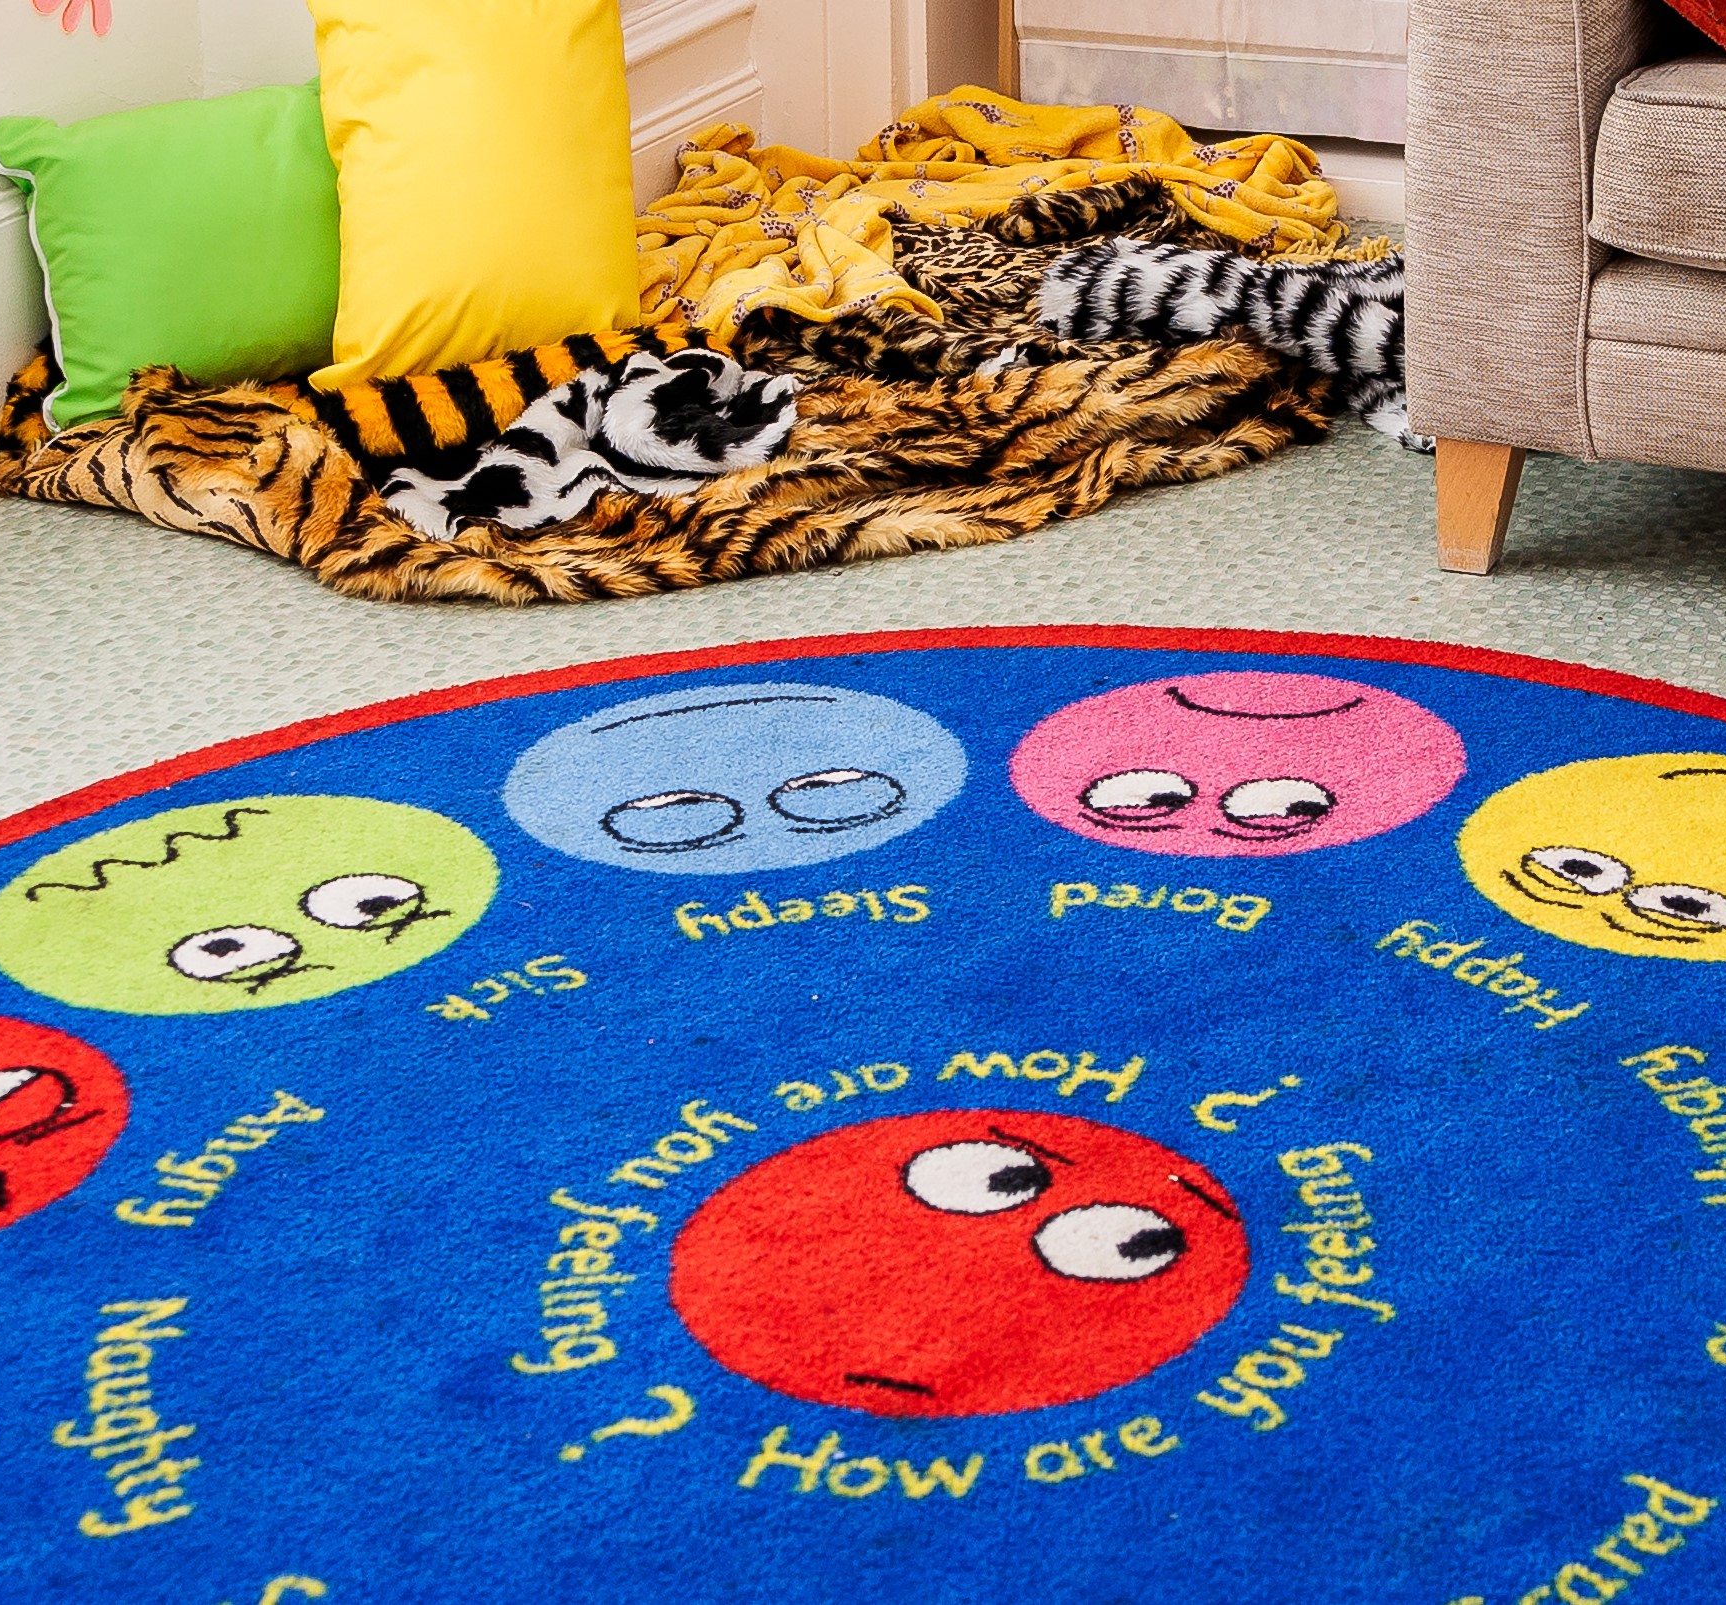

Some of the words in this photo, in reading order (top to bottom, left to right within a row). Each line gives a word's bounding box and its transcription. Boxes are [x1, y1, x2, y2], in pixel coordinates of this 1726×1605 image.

[674, 883, 930, 939] Sleepy
[1051, 882, 1272, 932] Bored
[427, 955, 587, 1020] Sick
[1377, 921, 1590, 1029] Happy
[776, 1060, 910, 1110] are
[937, 1050, 1145, 1103] How
[1191, 1073, 1302, 1132] ?
[116, 1091, 325, 1227] Angry
[608, 1100, 758, 1189] you
[1275, 1143, 1396, 1322] feeling
[512, 1189, 658, 1374] feeling
[1197, 1325, 1343, 1430] you
[53, 1298, 201, 1537] Naughty
[560, 1386, 695, 1462] ?
[1025, 1416, 1180, 1482] are
[737, 1427, 983, 1499] How
[1448, 1475, 1718, 1605] ared
